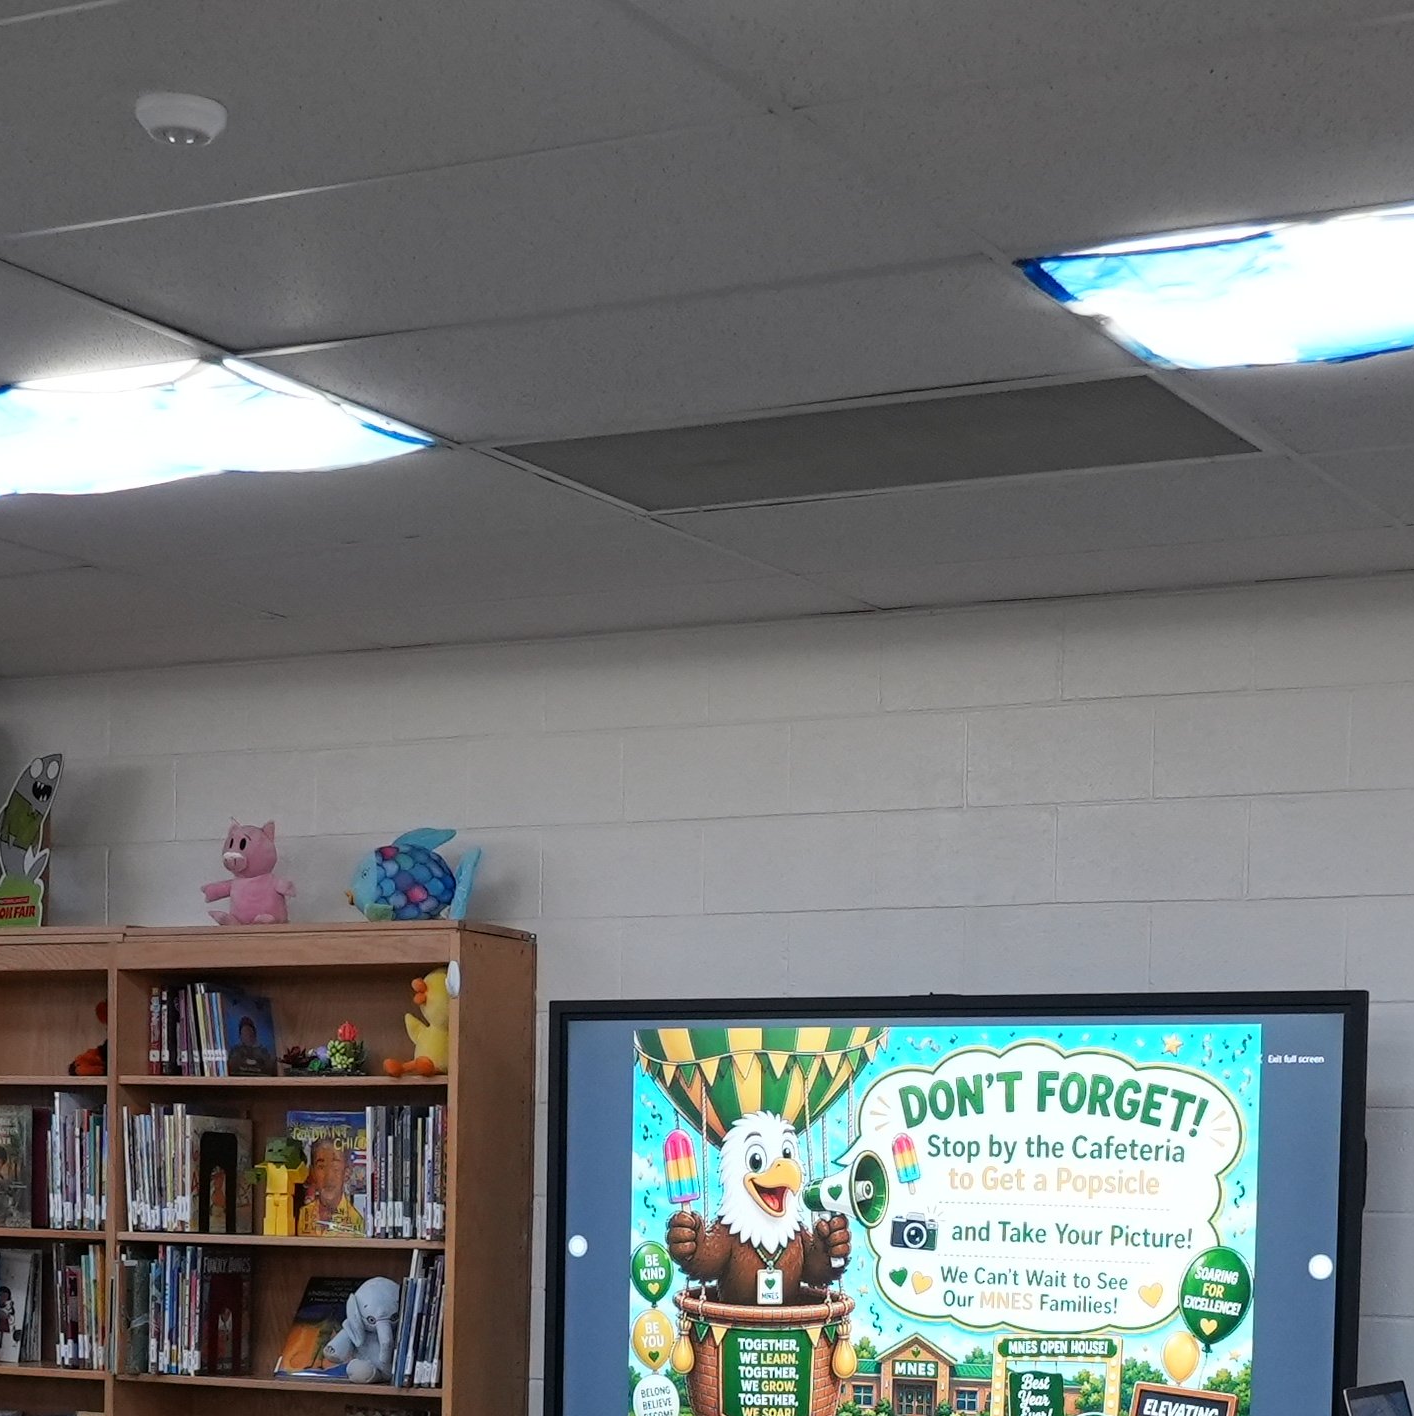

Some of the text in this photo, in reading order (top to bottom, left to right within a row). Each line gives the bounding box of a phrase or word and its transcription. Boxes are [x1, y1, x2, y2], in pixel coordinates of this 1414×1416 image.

[14, 906, 35, 918] FAIR
[1268, 1055, 1282, 1063] Exit
[1284, 1055, 1296, 1063] full
[899, 1070, 1208, 1137] DON'T FORGET!
[928, 1134, 1185, 1164] Stop by the Cafeteria
[949, 1167, 1159, 1199] to Get a Popsicle
[952, 1221, 1193, 1249] and Take Your Picture!
[645, 1254, 658, 1267] BE
[640, 1266, 665, 1280] KIND
[941, 1266, 1128, 1291] We Can't Wait to See
[1195, 1266, 1238, 1286] SOARING
[1201, 1283, 1224, 1298] FOR
[943, 1291, 1118, 1314] Our MNES Families!
[1184, 1296, 1241, 1316] EXCELLENCE!
[645, 1322, 659, 1334] BE
[641, 1334, 664, 1348] YOU
[738, 1338, 800, 1351] TOGETHER,
[1009, 1340, 1108, 1355] MNES OPEN HOUSE!
[740, 1353, 798, 1364] WE LEARN.
[738, 1366, 799, 1379] TOGETHER,
[895, 1361, 935, 1376] MNES
[741, 1380, 796, 1392] WE GROW.
[1020, 1374, 1050, 1391] Best
[641, 1386, 670, 1398] BELONG
[643, 1399, 672, 1410] BELIEVE
[739, 1394, 798, 1407] TOGETHER,
[1018, 1391, 1050, 1408] Year
